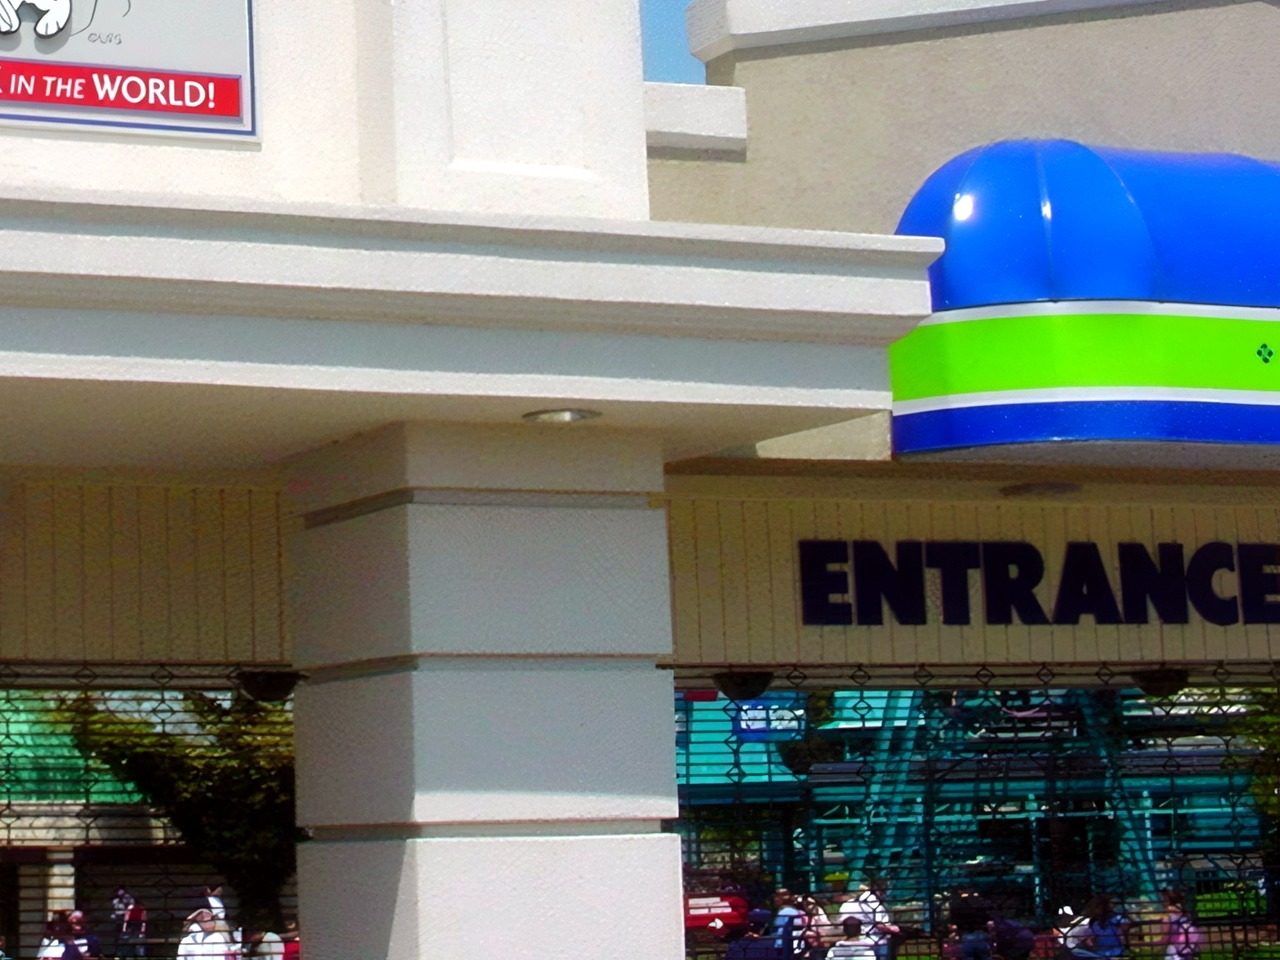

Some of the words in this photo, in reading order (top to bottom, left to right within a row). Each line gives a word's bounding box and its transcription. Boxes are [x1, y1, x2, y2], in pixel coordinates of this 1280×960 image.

[9, 73, 36, 96] IN
[42, 76, 87, 100] THE
[92, 73, 216, 108] WORLD!
[799, 540, 1280, 626] ENTRANCE
